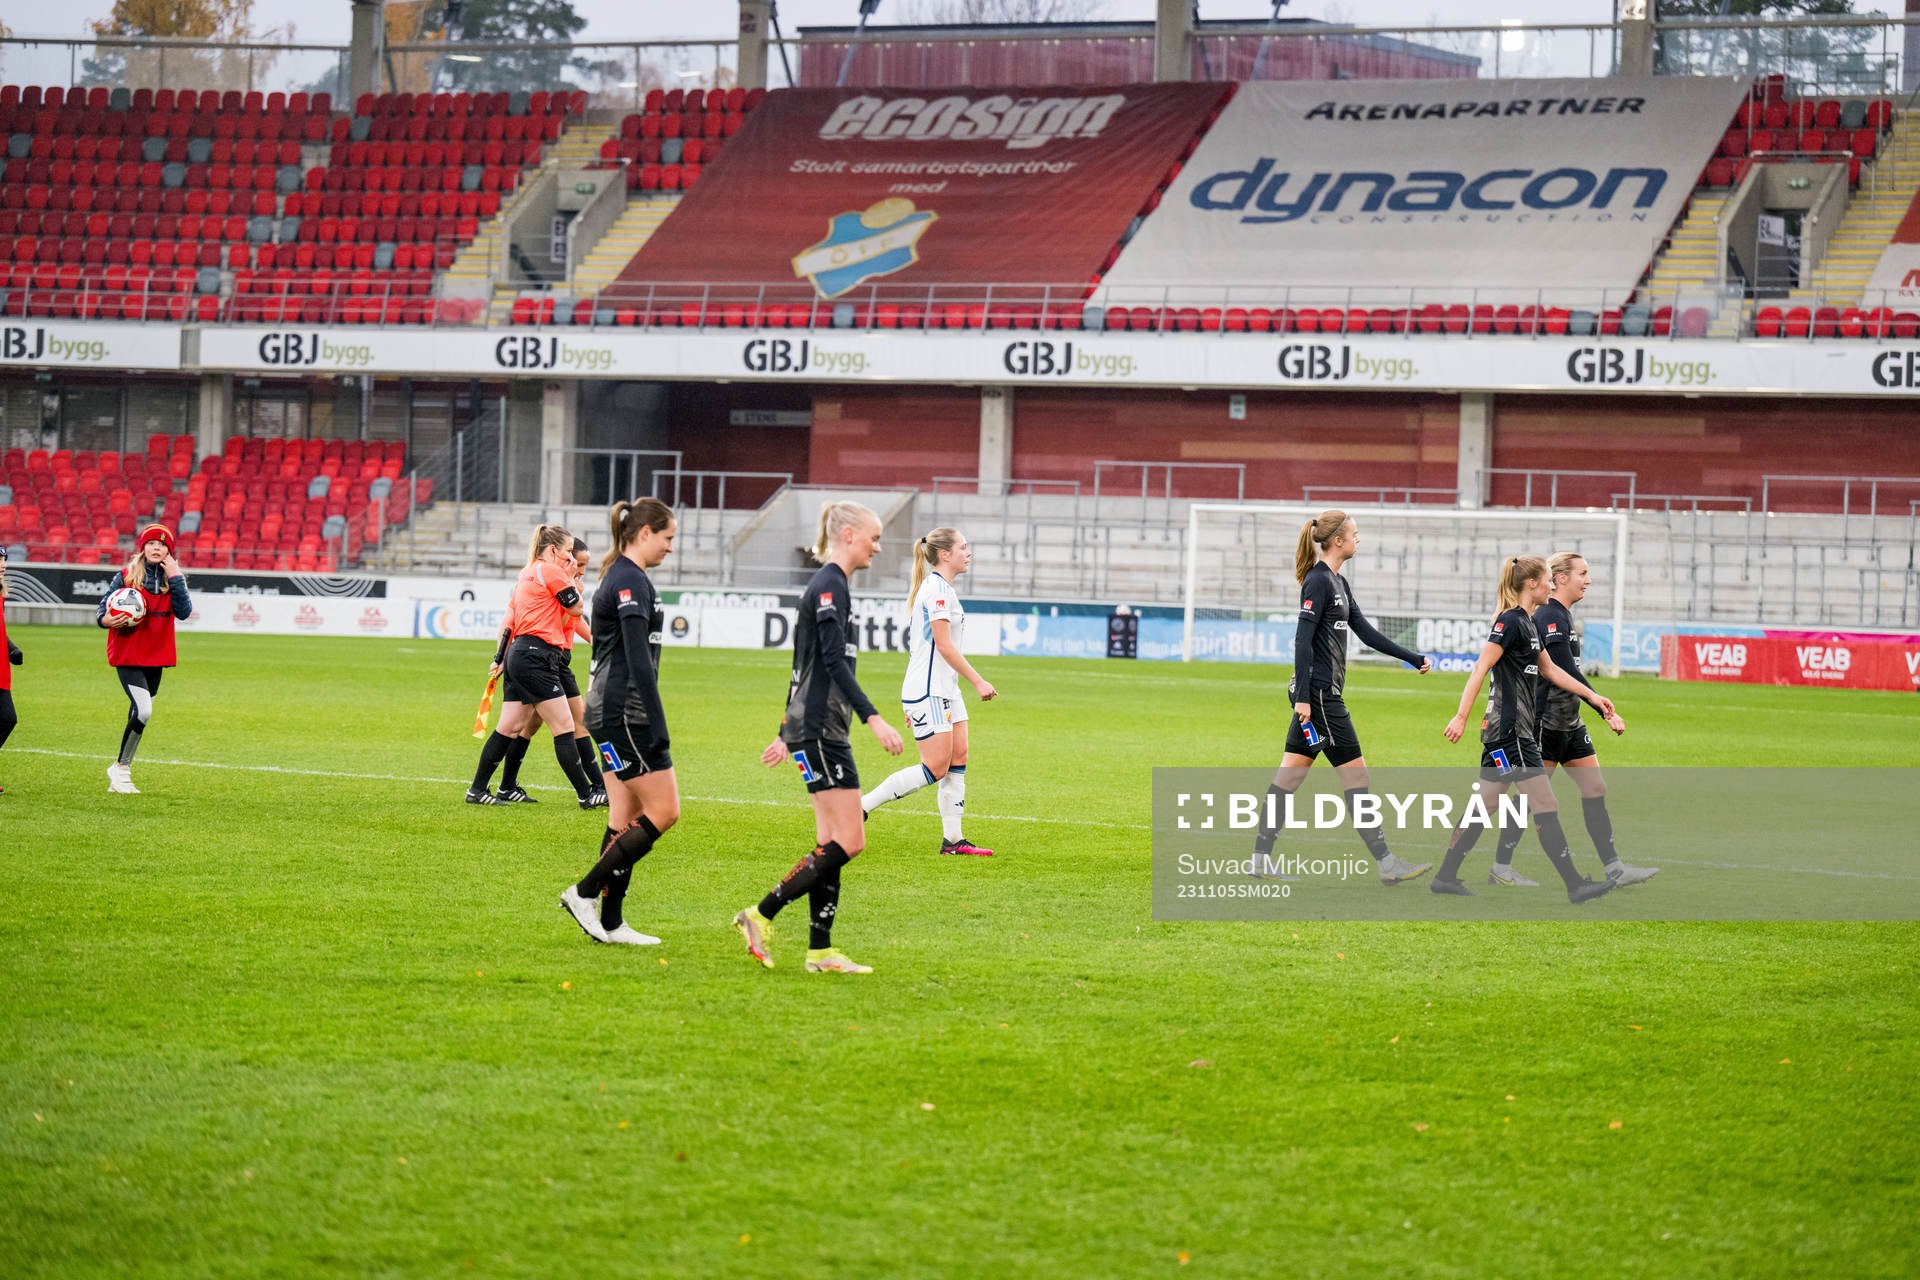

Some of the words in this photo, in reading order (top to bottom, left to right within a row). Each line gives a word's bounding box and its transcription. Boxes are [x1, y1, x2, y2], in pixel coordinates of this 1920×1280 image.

[819, 95, 1125, 148] ecosign
[1303, 97, 1647, 121] ARENAPARTNER
[789, 159, 848, 173] Stolt
[851, 160, 1077, 177] samarbetspartner
[888, 180, 947, 193] med
[1190, 157, 1668, 224] dynacon
[0, 327, 44, 359] BJ
[258, 333, 319, 365] GBJ
[495, 336, 557, 369] GBJ
[743, 339, 809, 373] GBJ
[1004, 341, 1072, 376] GBJ
[1278, 345, 1350, 380] GBJ
[1567, 348, 1644, 384] GBJ
[1695, 642, 1747, 667] VEAB
[1796, 645, 1851, 671] VEAB
